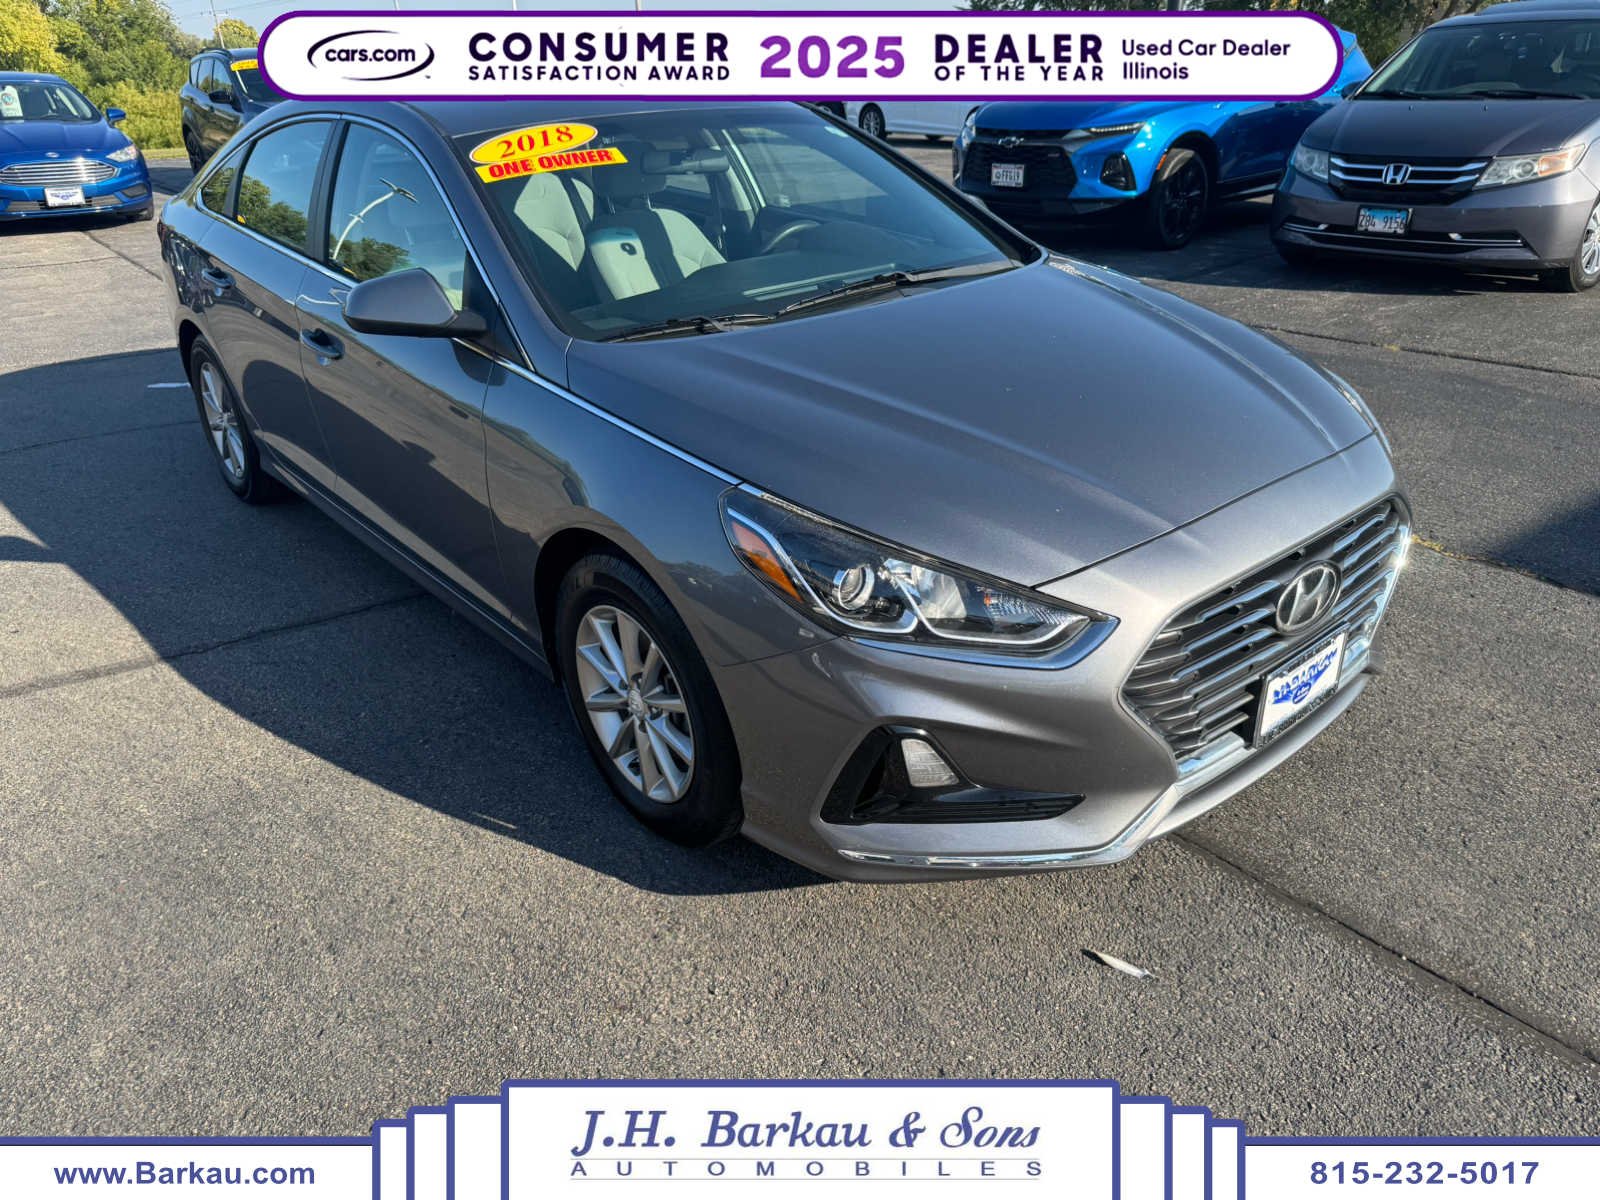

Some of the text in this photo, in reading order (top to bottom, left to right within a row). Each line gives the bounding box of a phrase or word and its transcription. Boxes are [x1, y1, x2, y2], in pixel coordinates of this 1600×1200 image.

[497, 125, 573, 158] 2018
[489, 150, 612, 178] ONE OWNER
